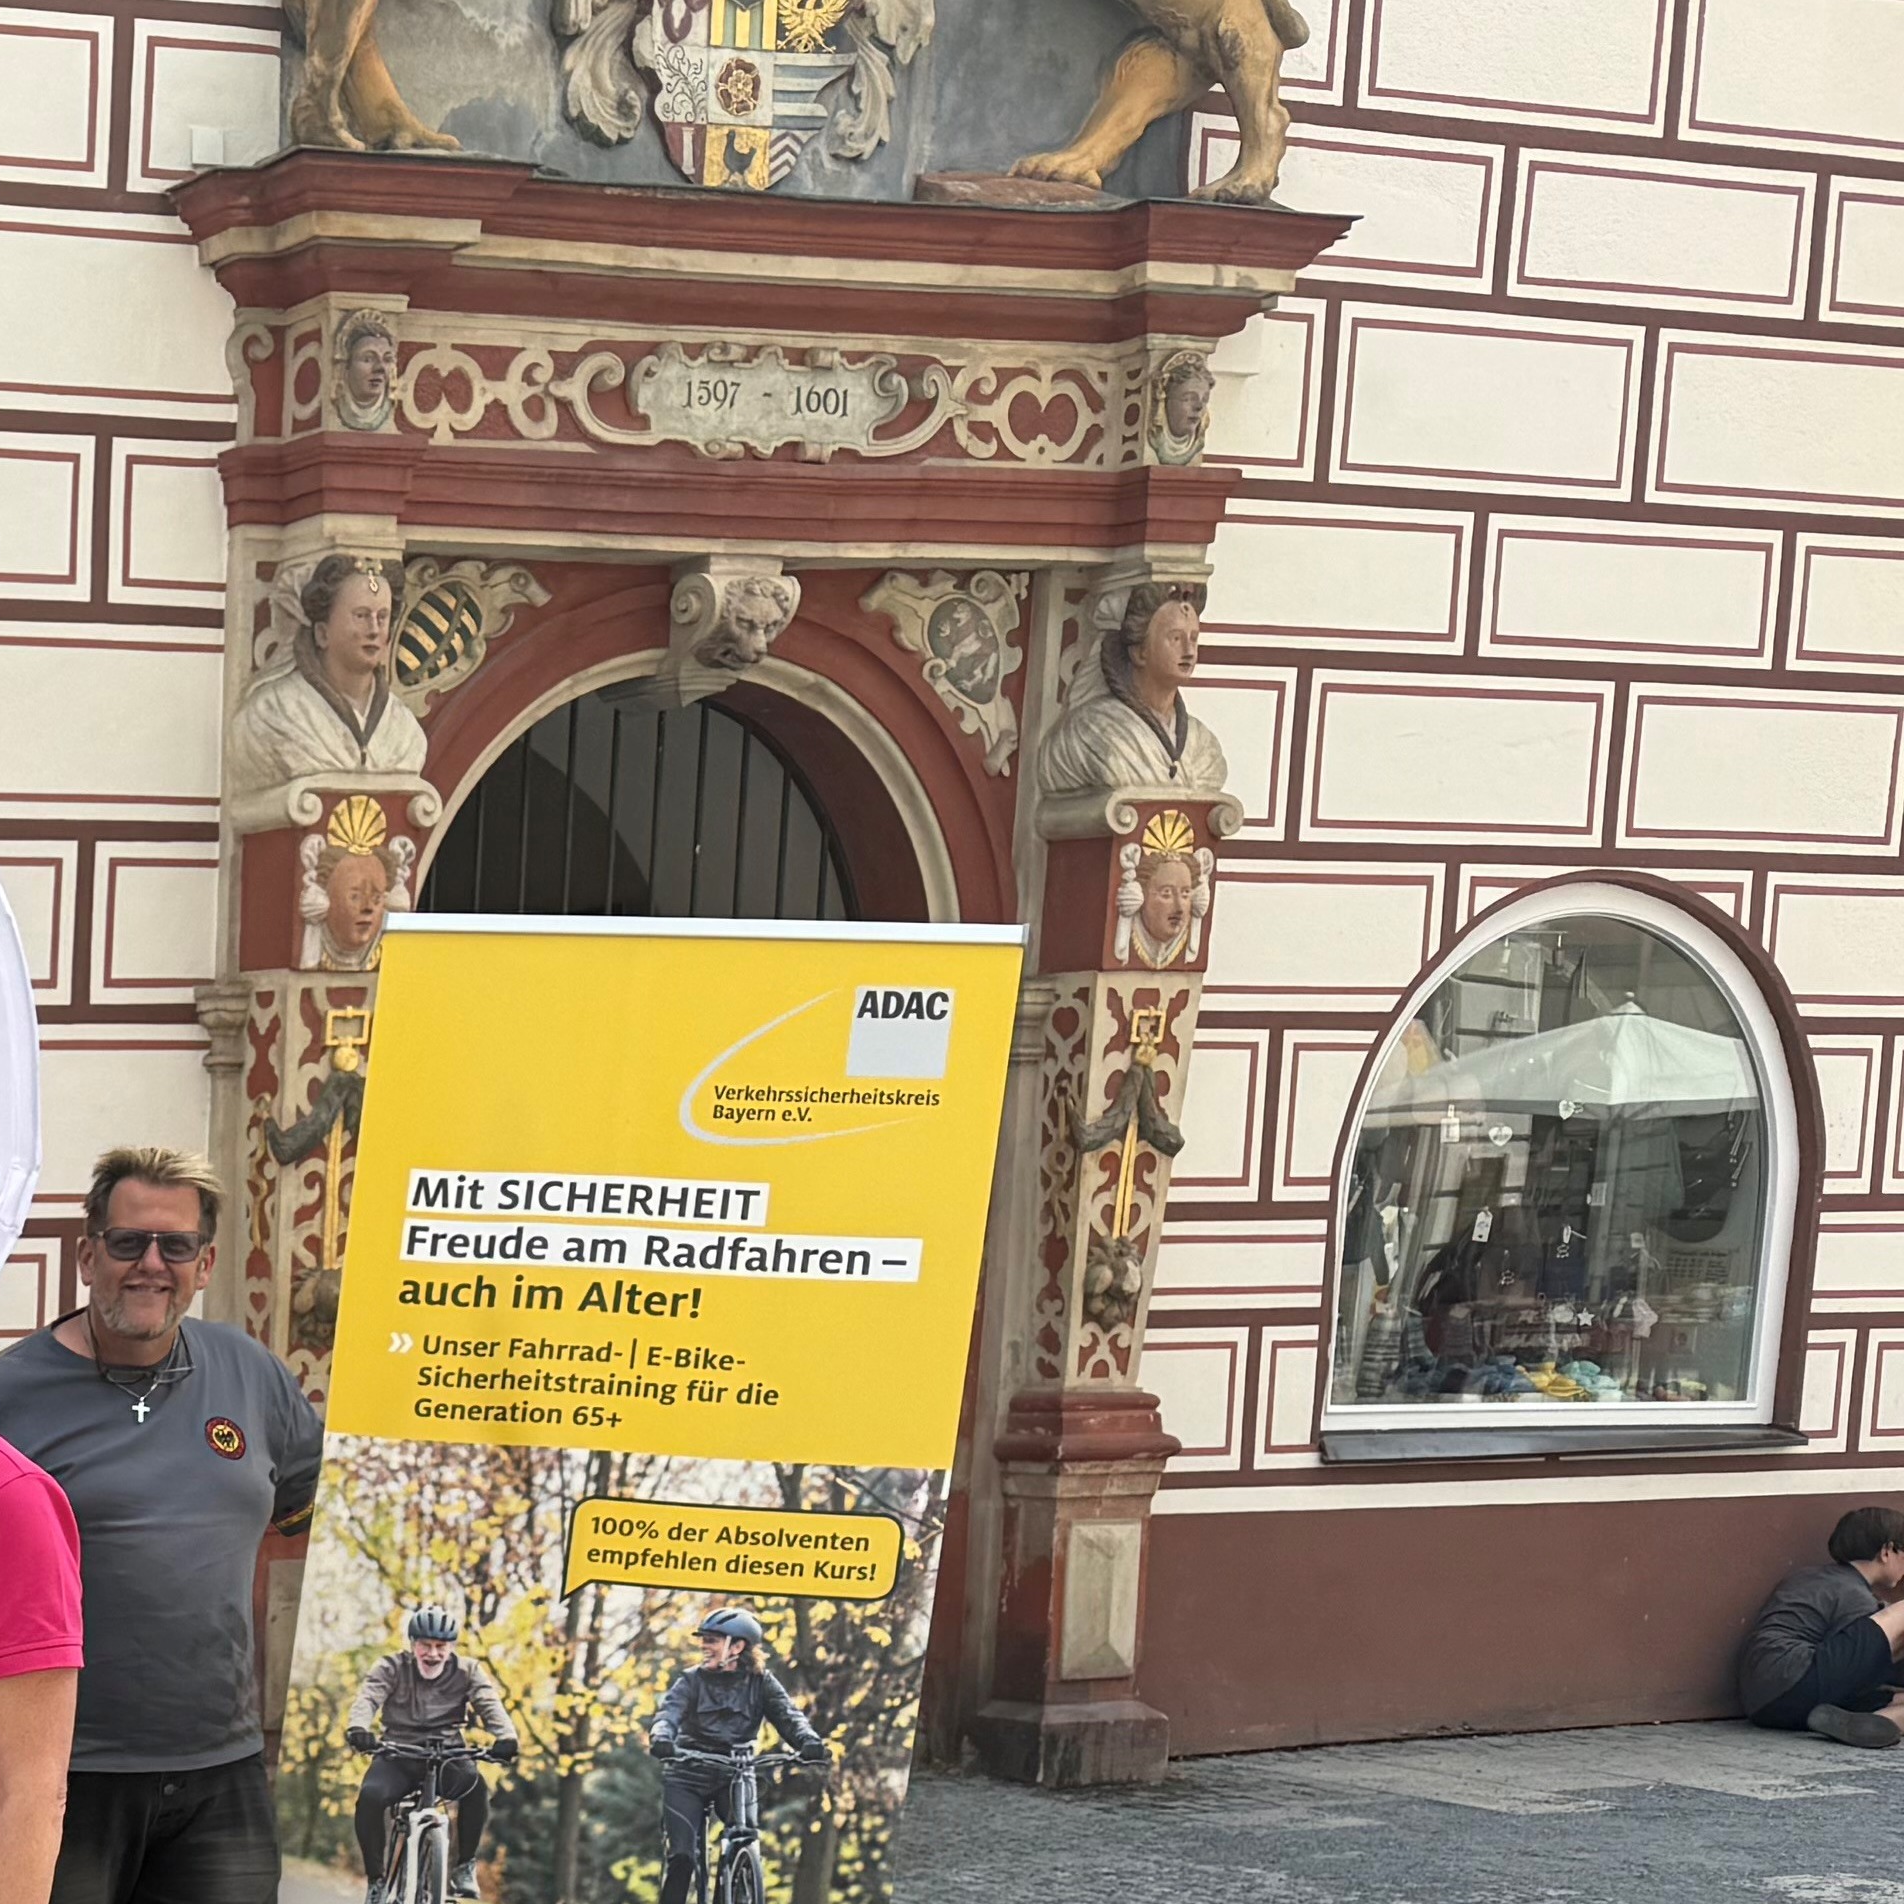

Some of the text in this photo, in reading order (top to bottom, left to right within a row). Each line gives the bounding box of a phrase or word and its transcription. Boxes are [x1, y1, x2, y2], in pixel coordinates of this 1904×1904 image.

[682, 379, 741, 412] 1597
[791, 384, 849, 417] 1601
[856, 990, 950, 1021] ADAC
[713, 1104, 812, 1123] Bayern e.V.
[714, 1085, 940, 1106] Verkehrssicherheitskreis
[411, 1174, 761, 1221] Mit SICHERHEIT
[405, 1225, 549, 1260] Freude
[562, 1237, 627, 1265] am
[644, 1235, 871, 1276] Radfahren
[398, 1273, 702, 1319] auch im Alter!
[422, 1334, 500, 1359] Unser
[508, 1337, 623, 1365] Fahrrad-
[646, 1345, 746, 1372] E-Bike-
[417, 1366, 780, 1407] Sicherheitstraining für die
[414, 1398, 623, 1429] Generation 65+
[591, 1516, 870, 1551] 100% der Absolventen
[586, 1547, 877, 1581] empfehlen diesen Kurs!
